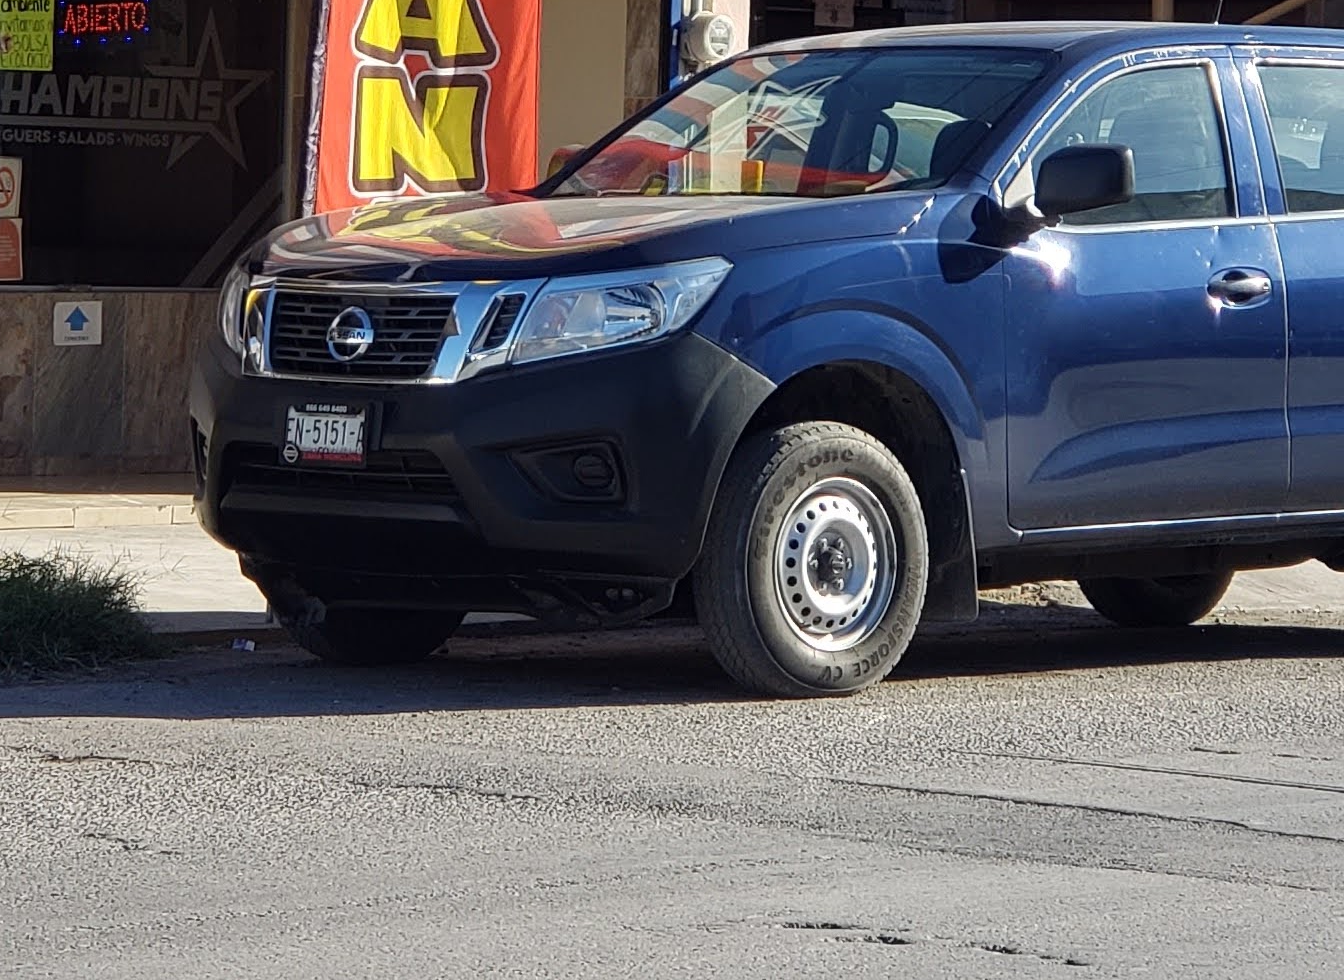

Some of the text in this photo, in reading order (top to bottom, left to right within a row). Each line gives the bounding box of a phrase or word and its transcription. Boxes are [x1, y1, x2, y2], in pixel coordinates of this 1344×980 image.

[64, 1, 147, 34] ABIERTO
[58, 131, 115, 146] SALADS
[121, 133, 169, 148] WINGS
